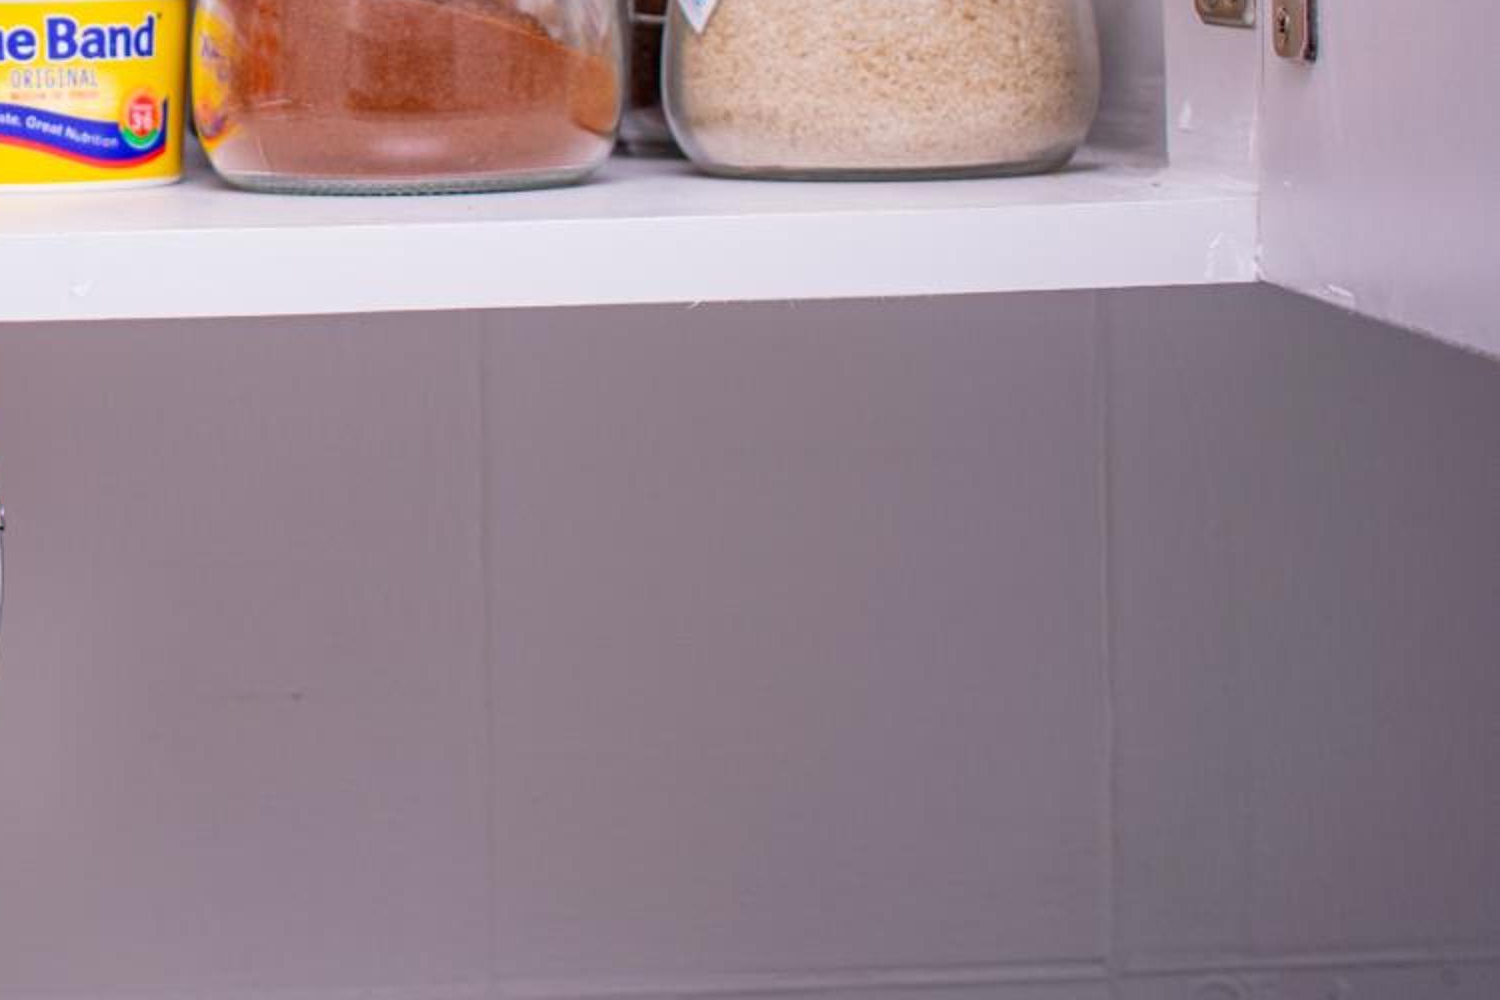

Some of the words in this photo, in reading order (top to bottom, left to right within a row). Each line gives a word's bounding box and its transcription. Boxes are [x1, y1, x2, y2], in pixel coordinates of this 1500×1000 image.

[46, 14, 155, 59] Band
[10, 68, 100, 89] ORIGINAL
[25, 115, 64, 137] Great
[65, 127, 119, 149] Nutrition
